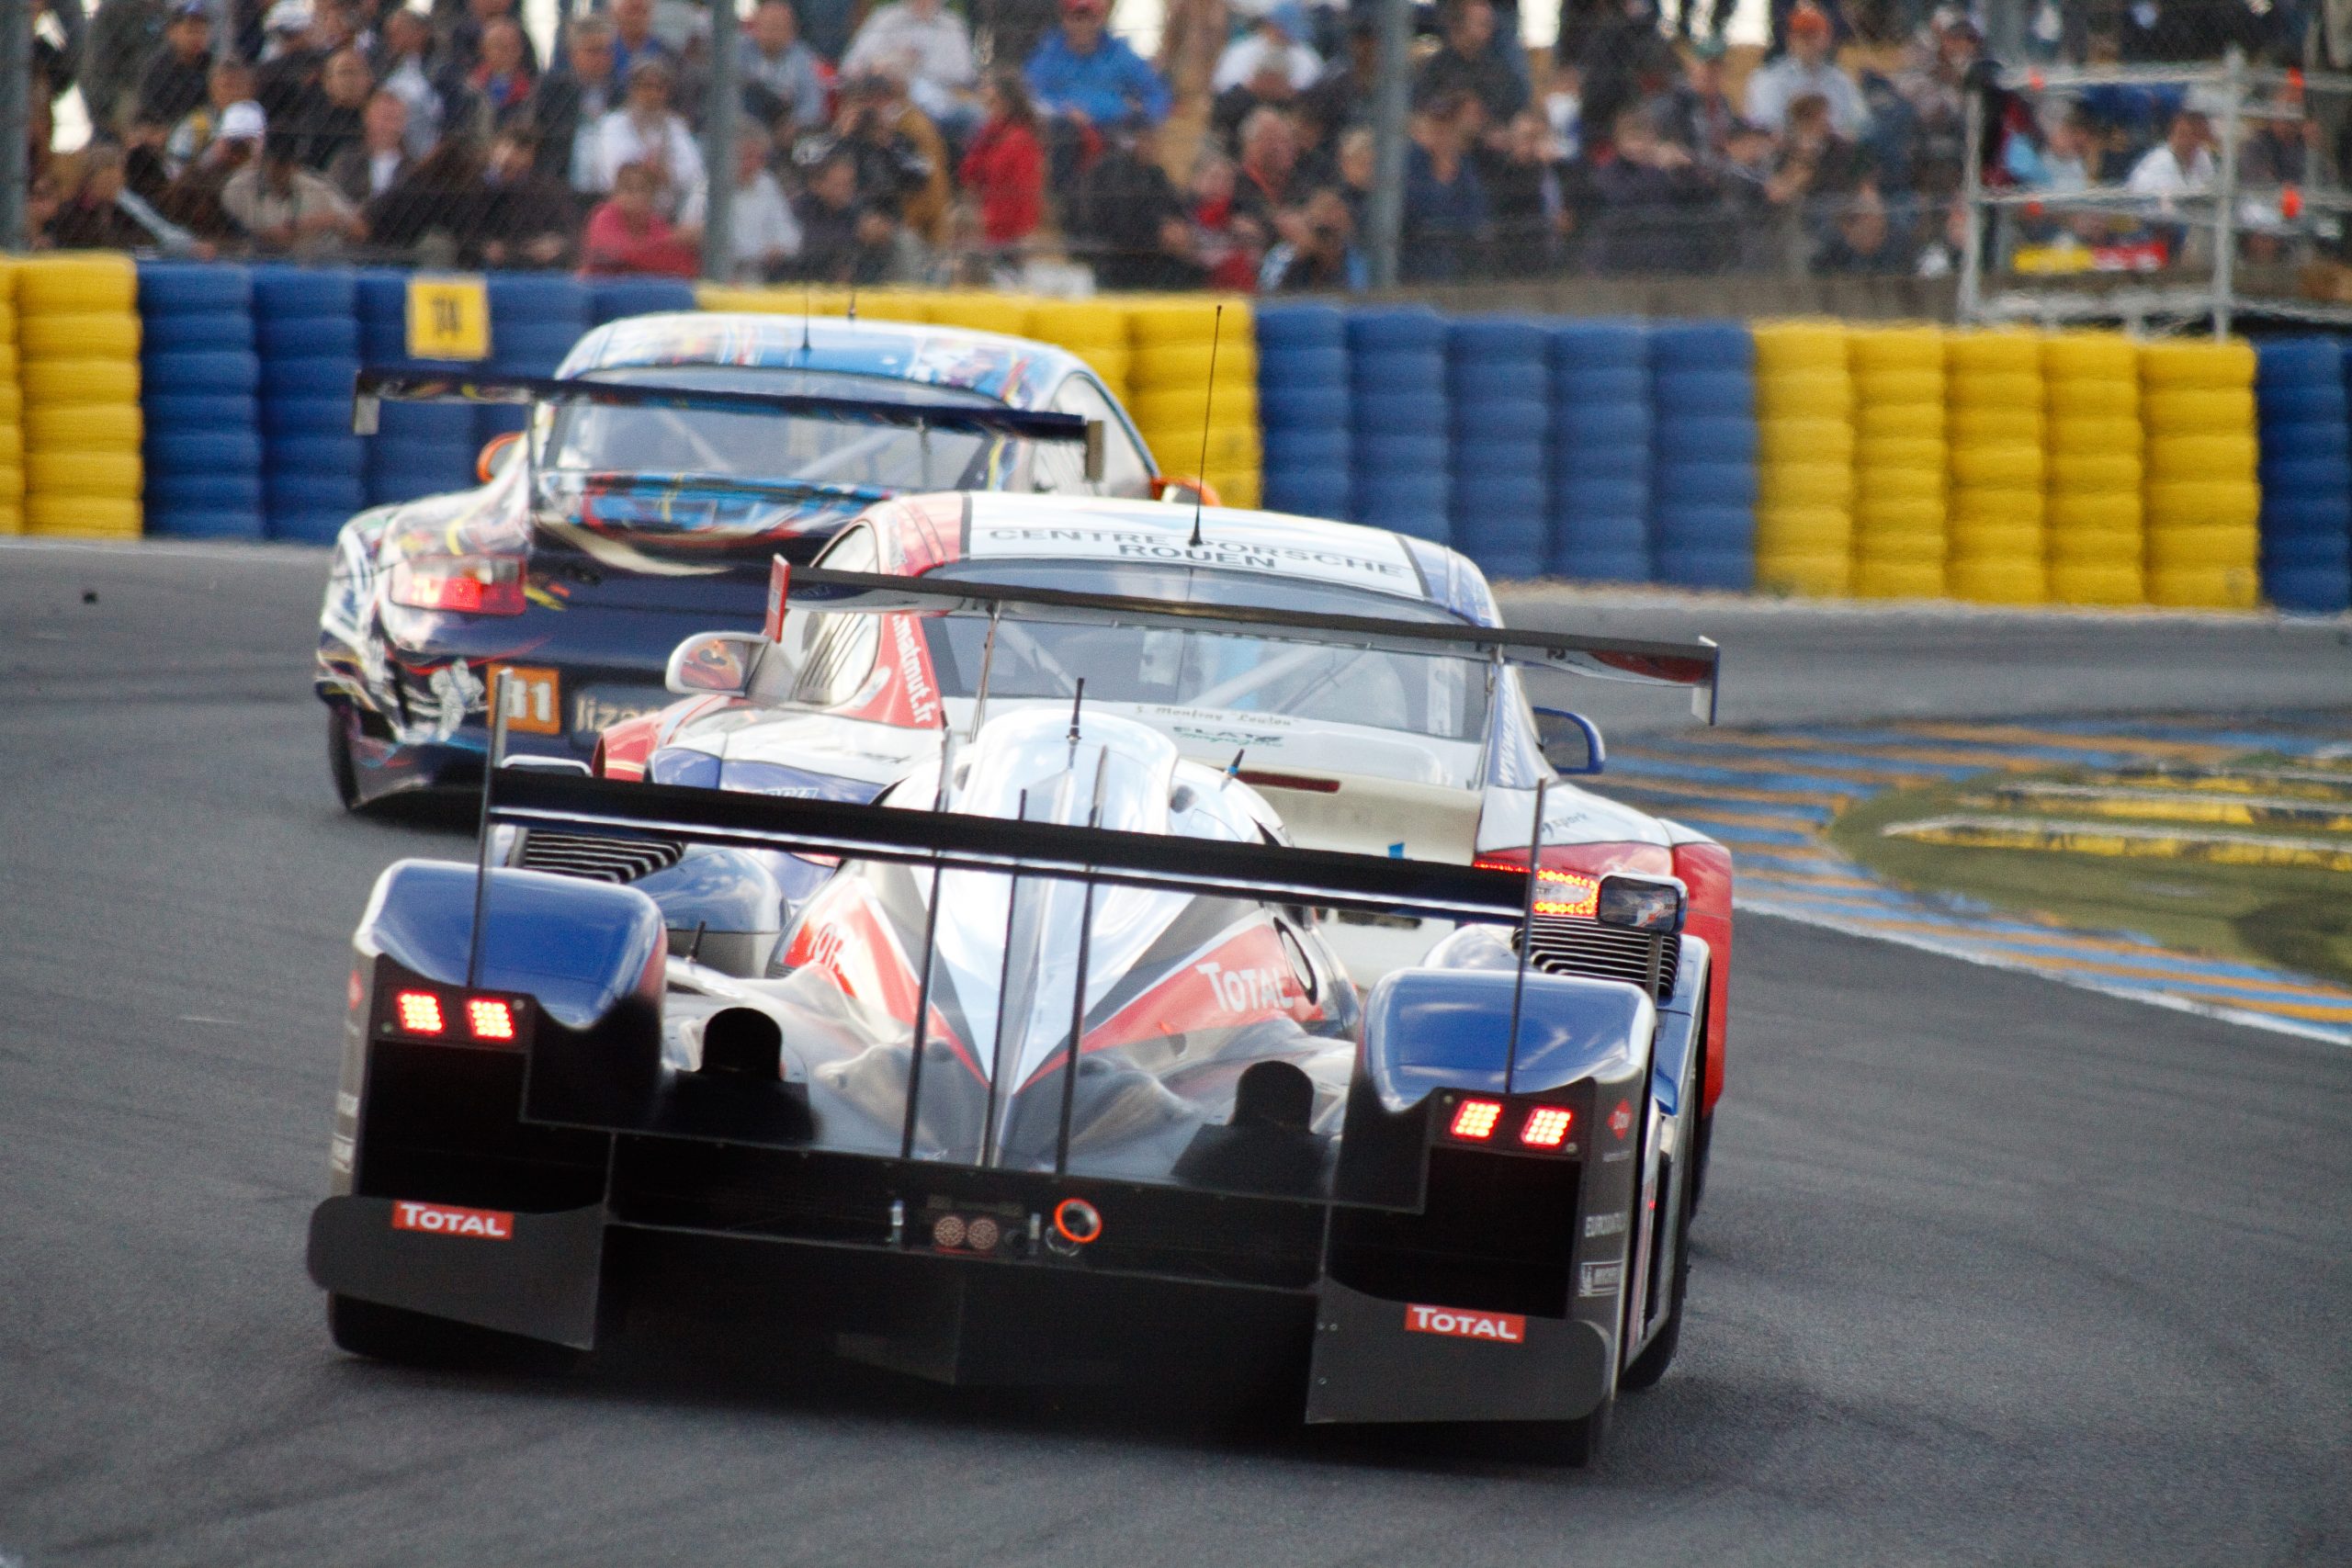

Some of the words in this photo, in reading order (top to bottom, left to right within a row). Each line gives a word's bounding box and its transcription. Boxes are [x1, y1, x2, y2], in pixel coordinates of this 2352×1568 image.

[989, 529, 1170, 546] CENTRE
[1118, 544, 1276, 569] ROUEN
[1195, 962, 1295, 1013] TOTAL
[400, 1203, 507, 1236] TOTAL
[1412, 1306, 1519, 1340] TOTAL
